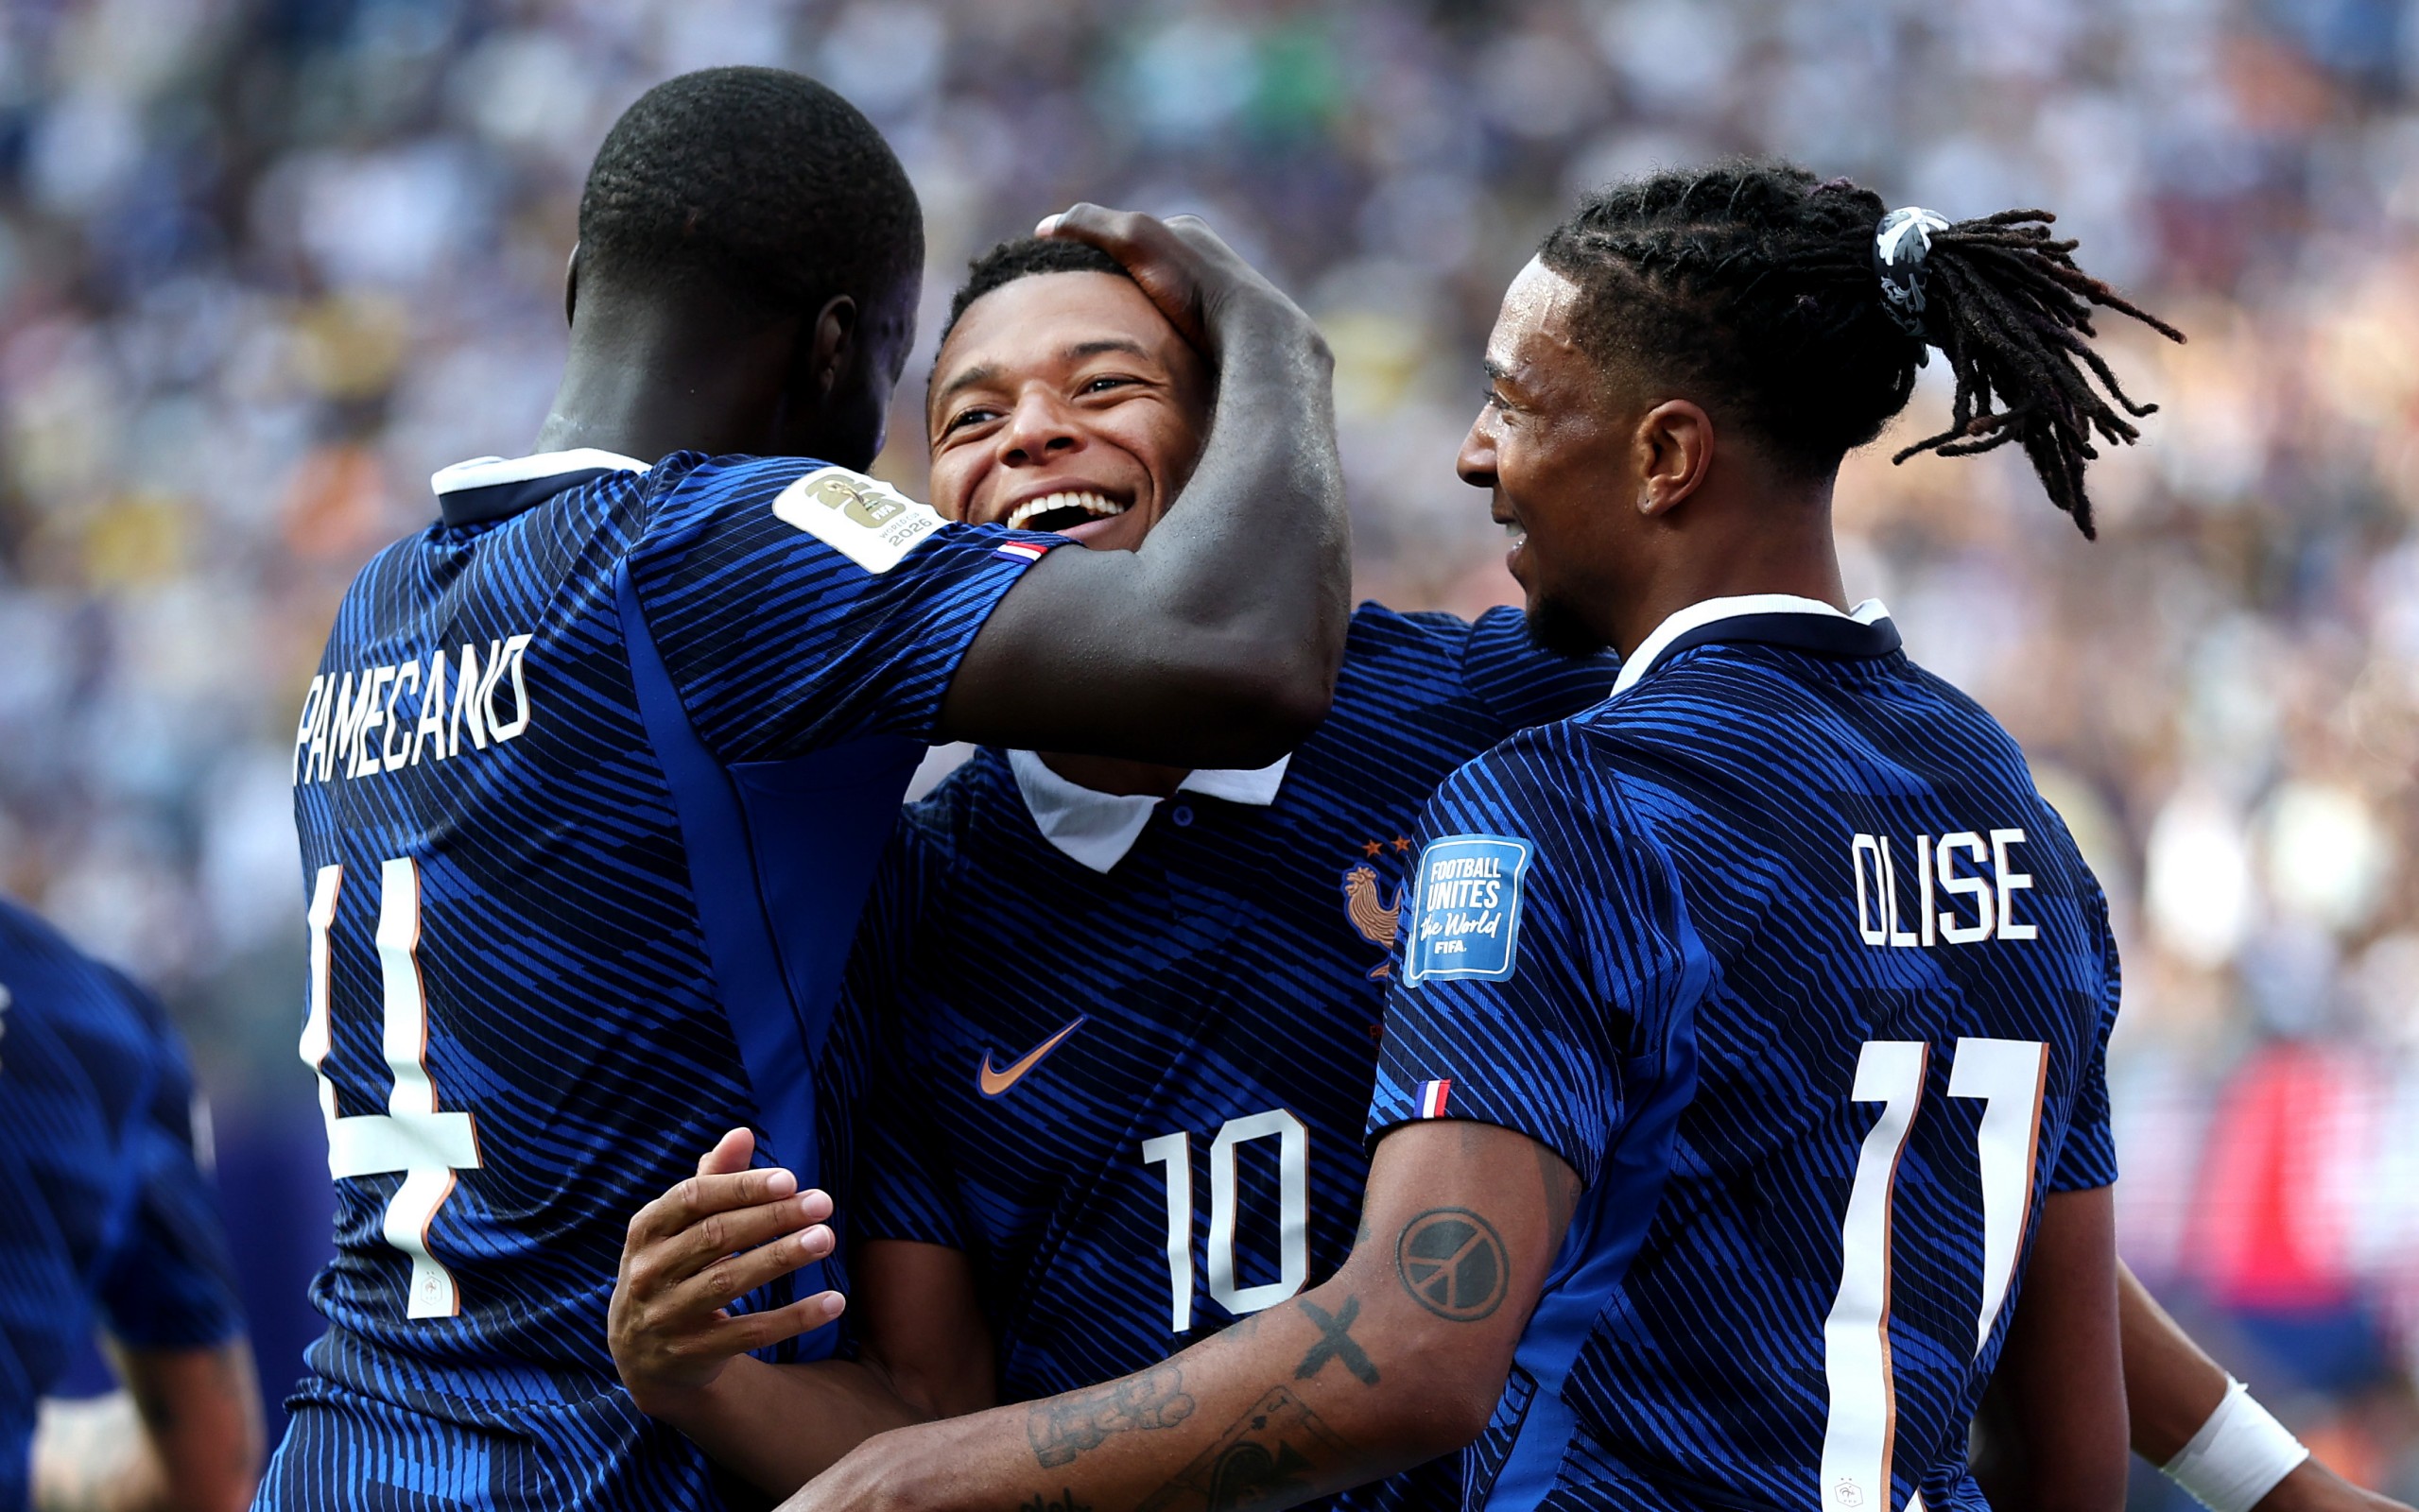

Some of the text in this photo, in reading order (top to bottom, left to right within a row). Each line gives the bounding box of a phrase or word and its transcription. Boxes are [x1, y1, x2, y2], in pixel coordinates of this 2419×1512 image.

[871, 504, 897, 521] FIFA
[879, 519, 907, 539] WORLD
[889, 518, 933, 547] 2026
[1430, 857, 1502, 884] FOOTBALL
[1426, 879, 1501, 913] UNITES
[1852, 828, 2039, 948] OLISE
[1420, 909, 1502, 942] the World
[1434, 939, 1466, 954] FIFA
[299, 856, 484, 1320] 4
[1141, 1107, 1311, 1333] 10
[1819, 1036, 2050, 1512] 11
